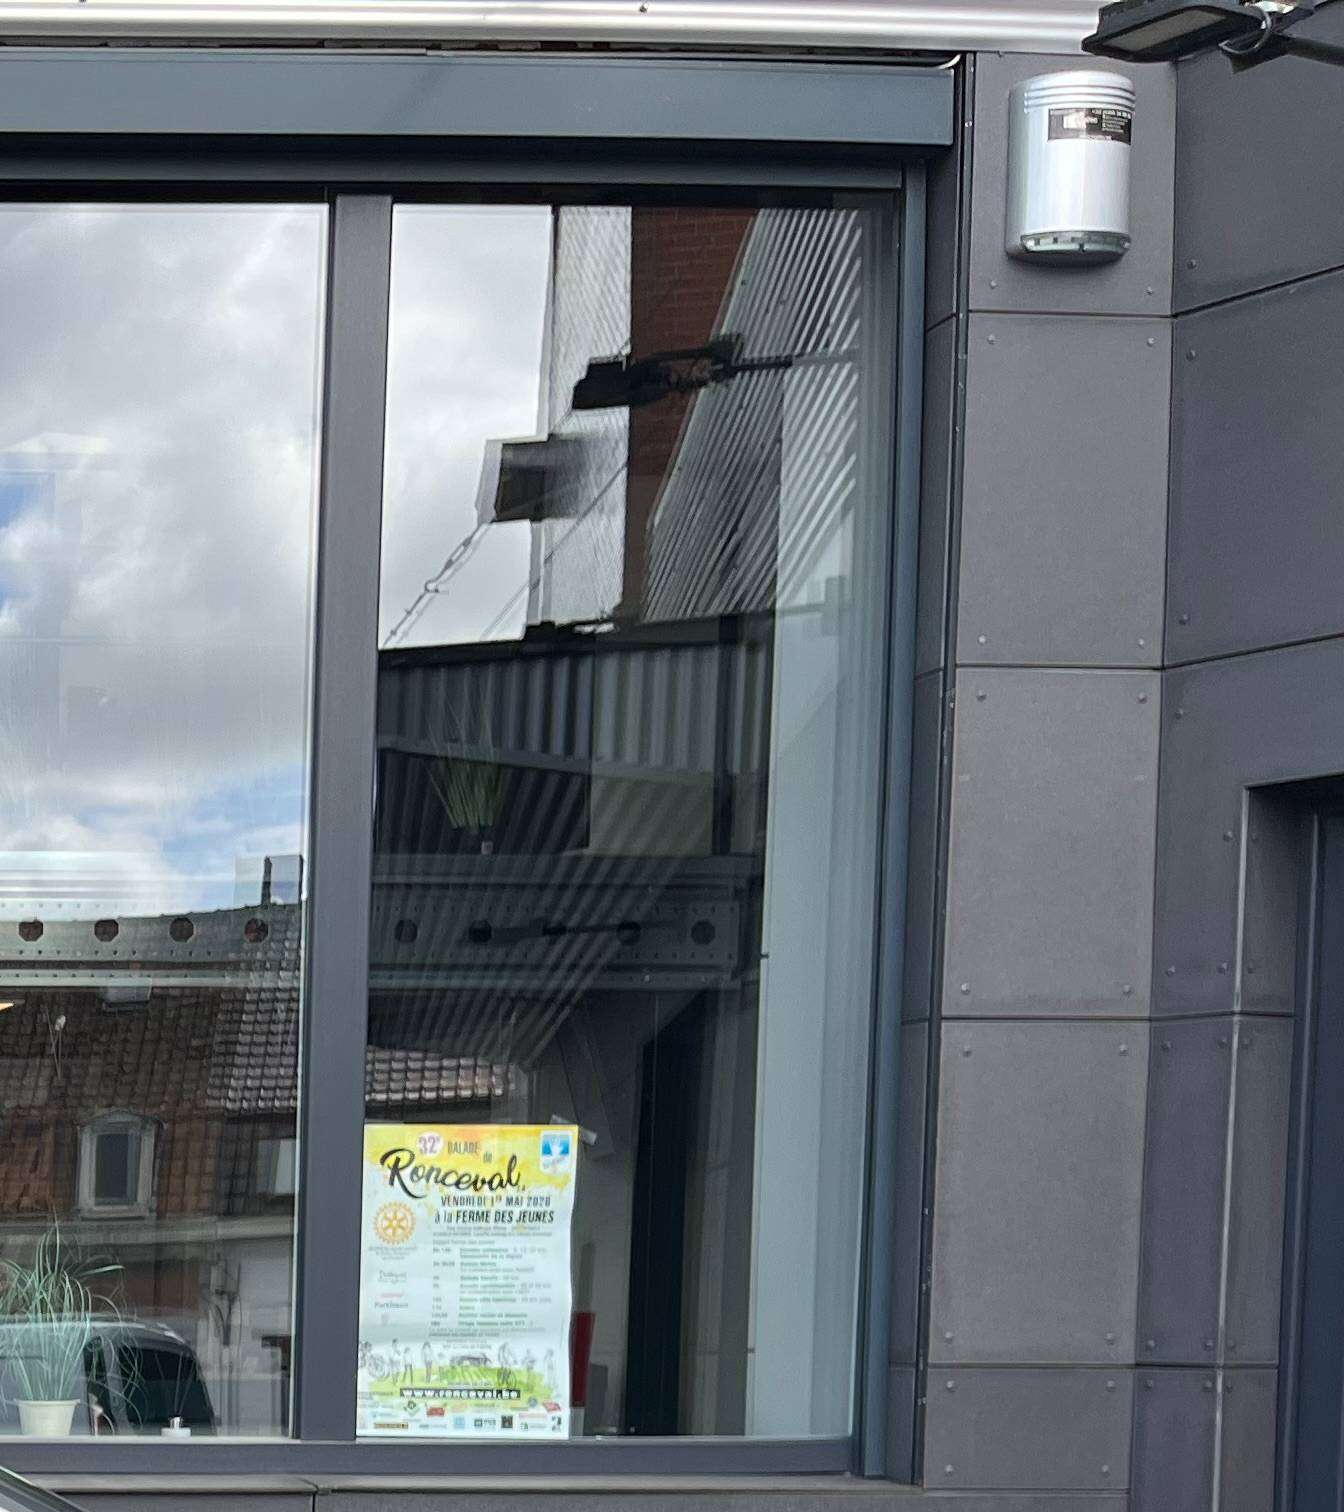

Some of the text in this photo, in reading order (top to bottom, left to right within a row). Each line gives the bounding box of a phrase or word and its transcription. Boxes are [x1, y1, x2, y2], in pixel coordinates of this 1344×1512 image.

[379, 1147, 521, 1199] Ronceval
[441, 1195, 487, 1207] VENDREDI
[506, 1195, 524, 1207] MAI
[444, 1210, 453, 1224] la
[455, 1210, 492, 1224] FERME
[494, 1210, 514, 1224] DES
[516, 1210, 555, 1224] JEUNES
